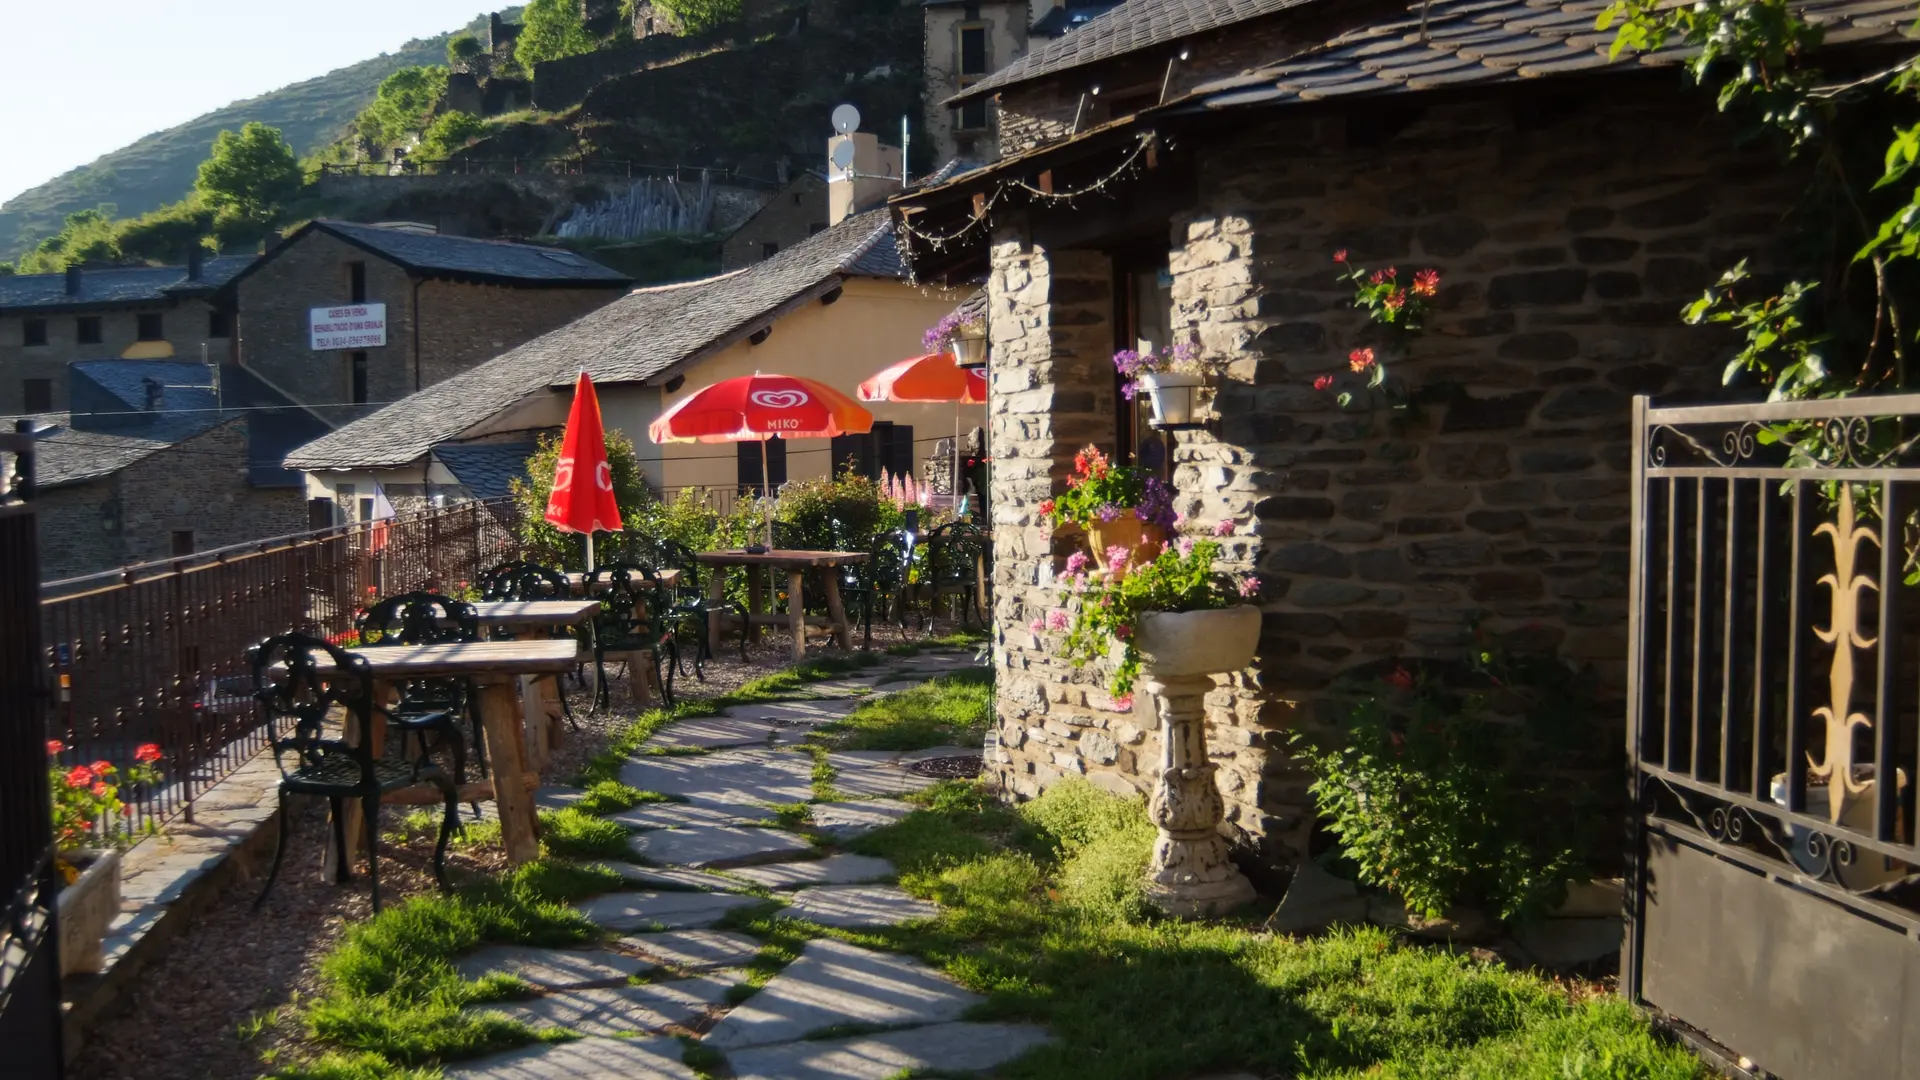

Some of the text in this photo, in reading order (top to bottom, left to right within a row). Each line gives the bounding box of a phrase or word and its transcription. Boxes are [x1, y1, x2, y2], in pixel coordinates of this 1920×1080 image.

[352, 308, 368, 316] VENDA
[364, 320, 383, 330] GRANJA
[767, 418, 799, 430] MIKO
